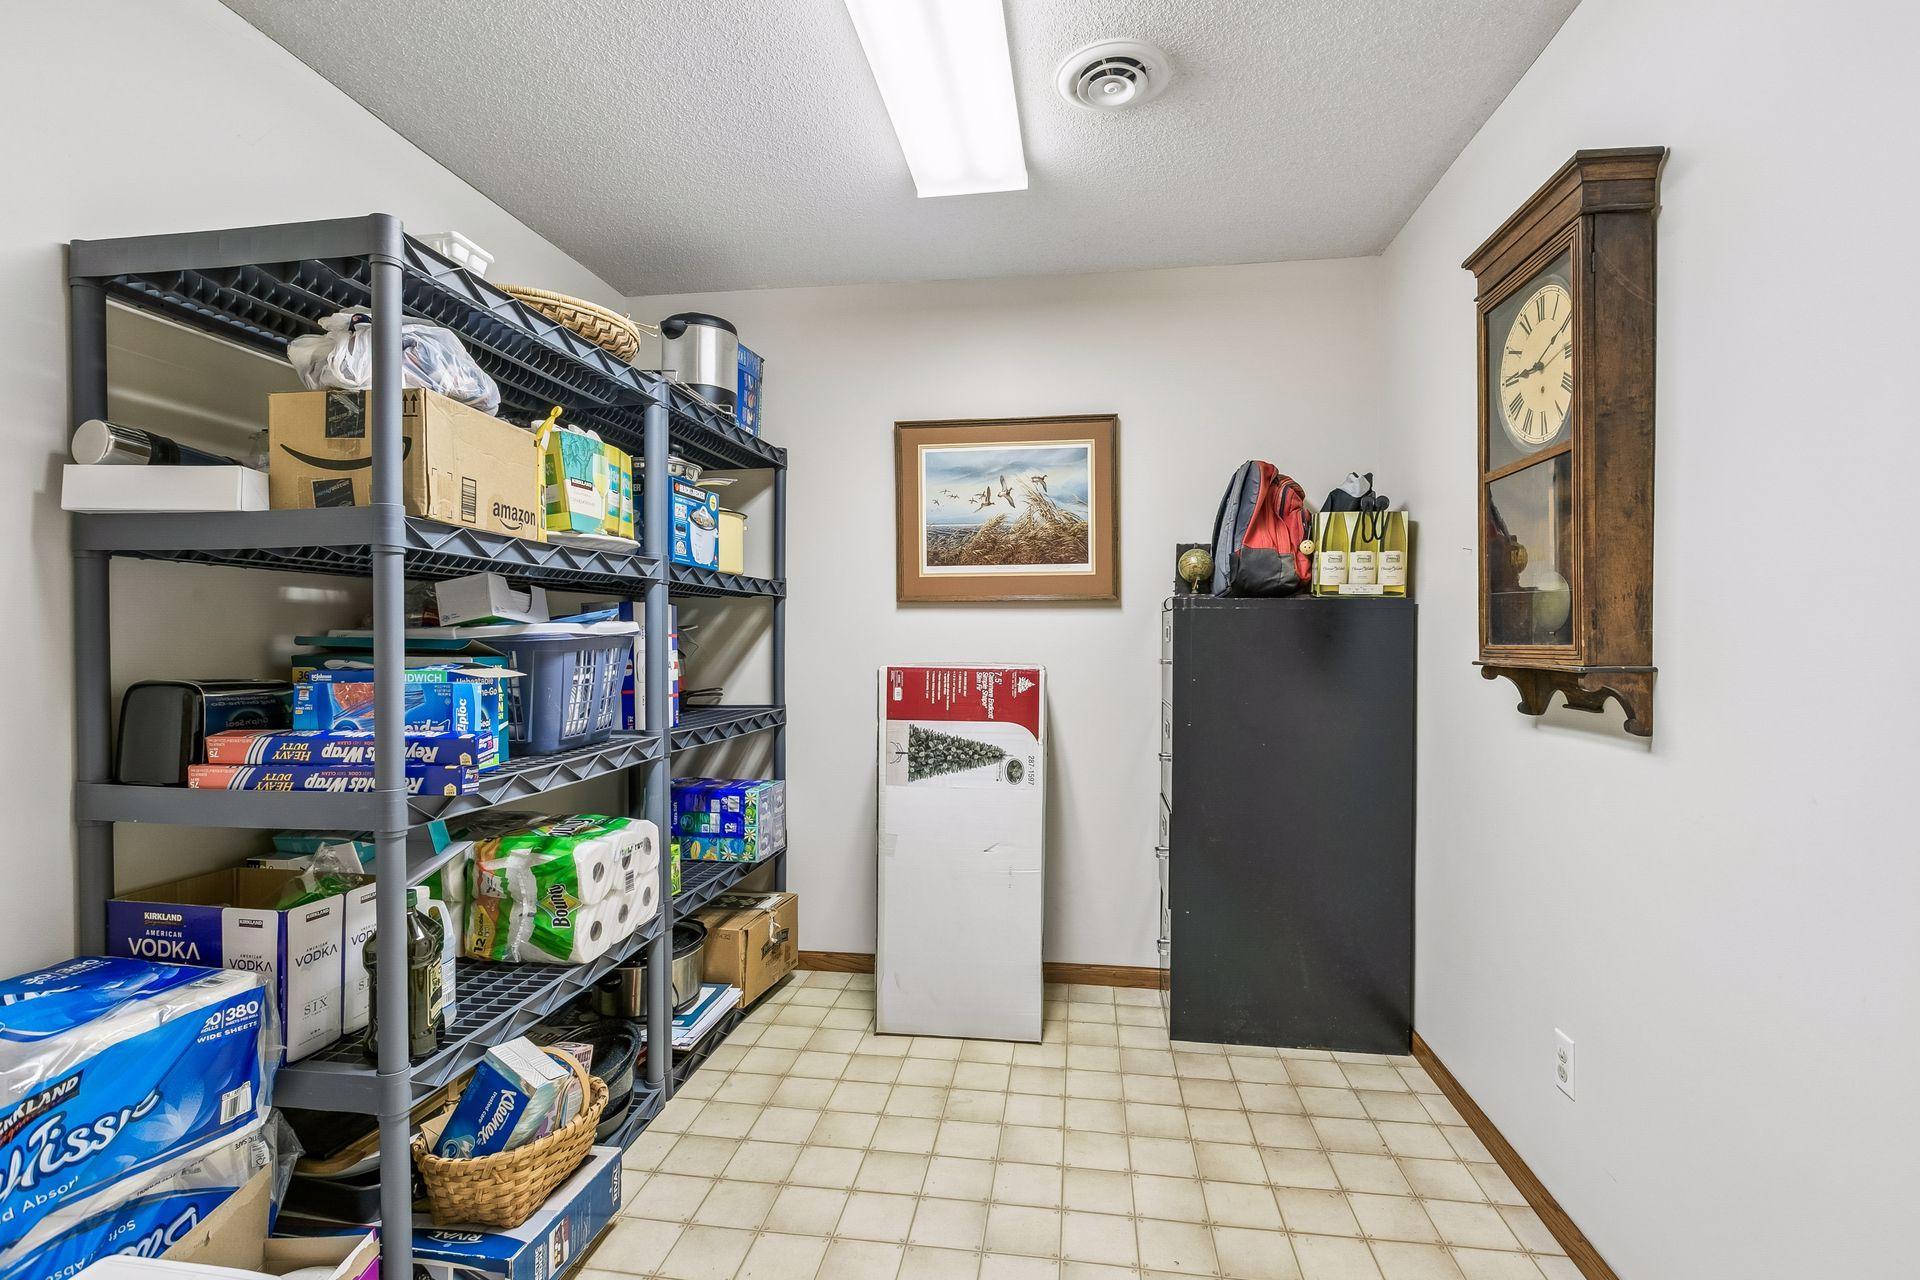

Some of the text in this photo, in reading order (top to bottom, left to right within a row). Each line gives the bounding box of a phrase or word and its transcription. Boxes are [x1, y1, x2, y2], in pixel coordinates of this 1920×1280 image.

[493, 501, 536, 527] amazon
[298, 670, 309, 680] 36
[457, 698, 469, 732] Ziploc
[209, 750, 219, 758] 75
[272, 750, 312, 761] HEAVY
[280, 742, 309, 751] DUTY
[321, 742, 364, 763] Wrap
[253, 781, 294, 792] HEAVY
[262, 773, 292, 781] DUTY
[304, 773, 349, 792] Wrap
[724, 822, 734, 834] 12
[306, 907, 330, 920] KIRKLAND
[547, 884, 572, 928] Bounty
[144, 911, 183, 922] KIRKLAND
[145, 929, 183, 938] AMERICAN
[473, 913, 486, 953] 12 Double
[128, 937, 201, 961] VODKA
[295, 944, 338, 967] VODKA
[229, 958, 273, 973] VODKA
[225, 1000, 259, 1021] 380
[304, 995, 328, 1016] SIX
[197, 1020, 258, 1044] WIDE SHEETS
[477, 1088, 517, 1145] Kleenex
[478, 1091, 498, 1125] trusted care
[108, 1219, 136, 1242] Soft
[433, 1231, 483, 1242] RIVAL
